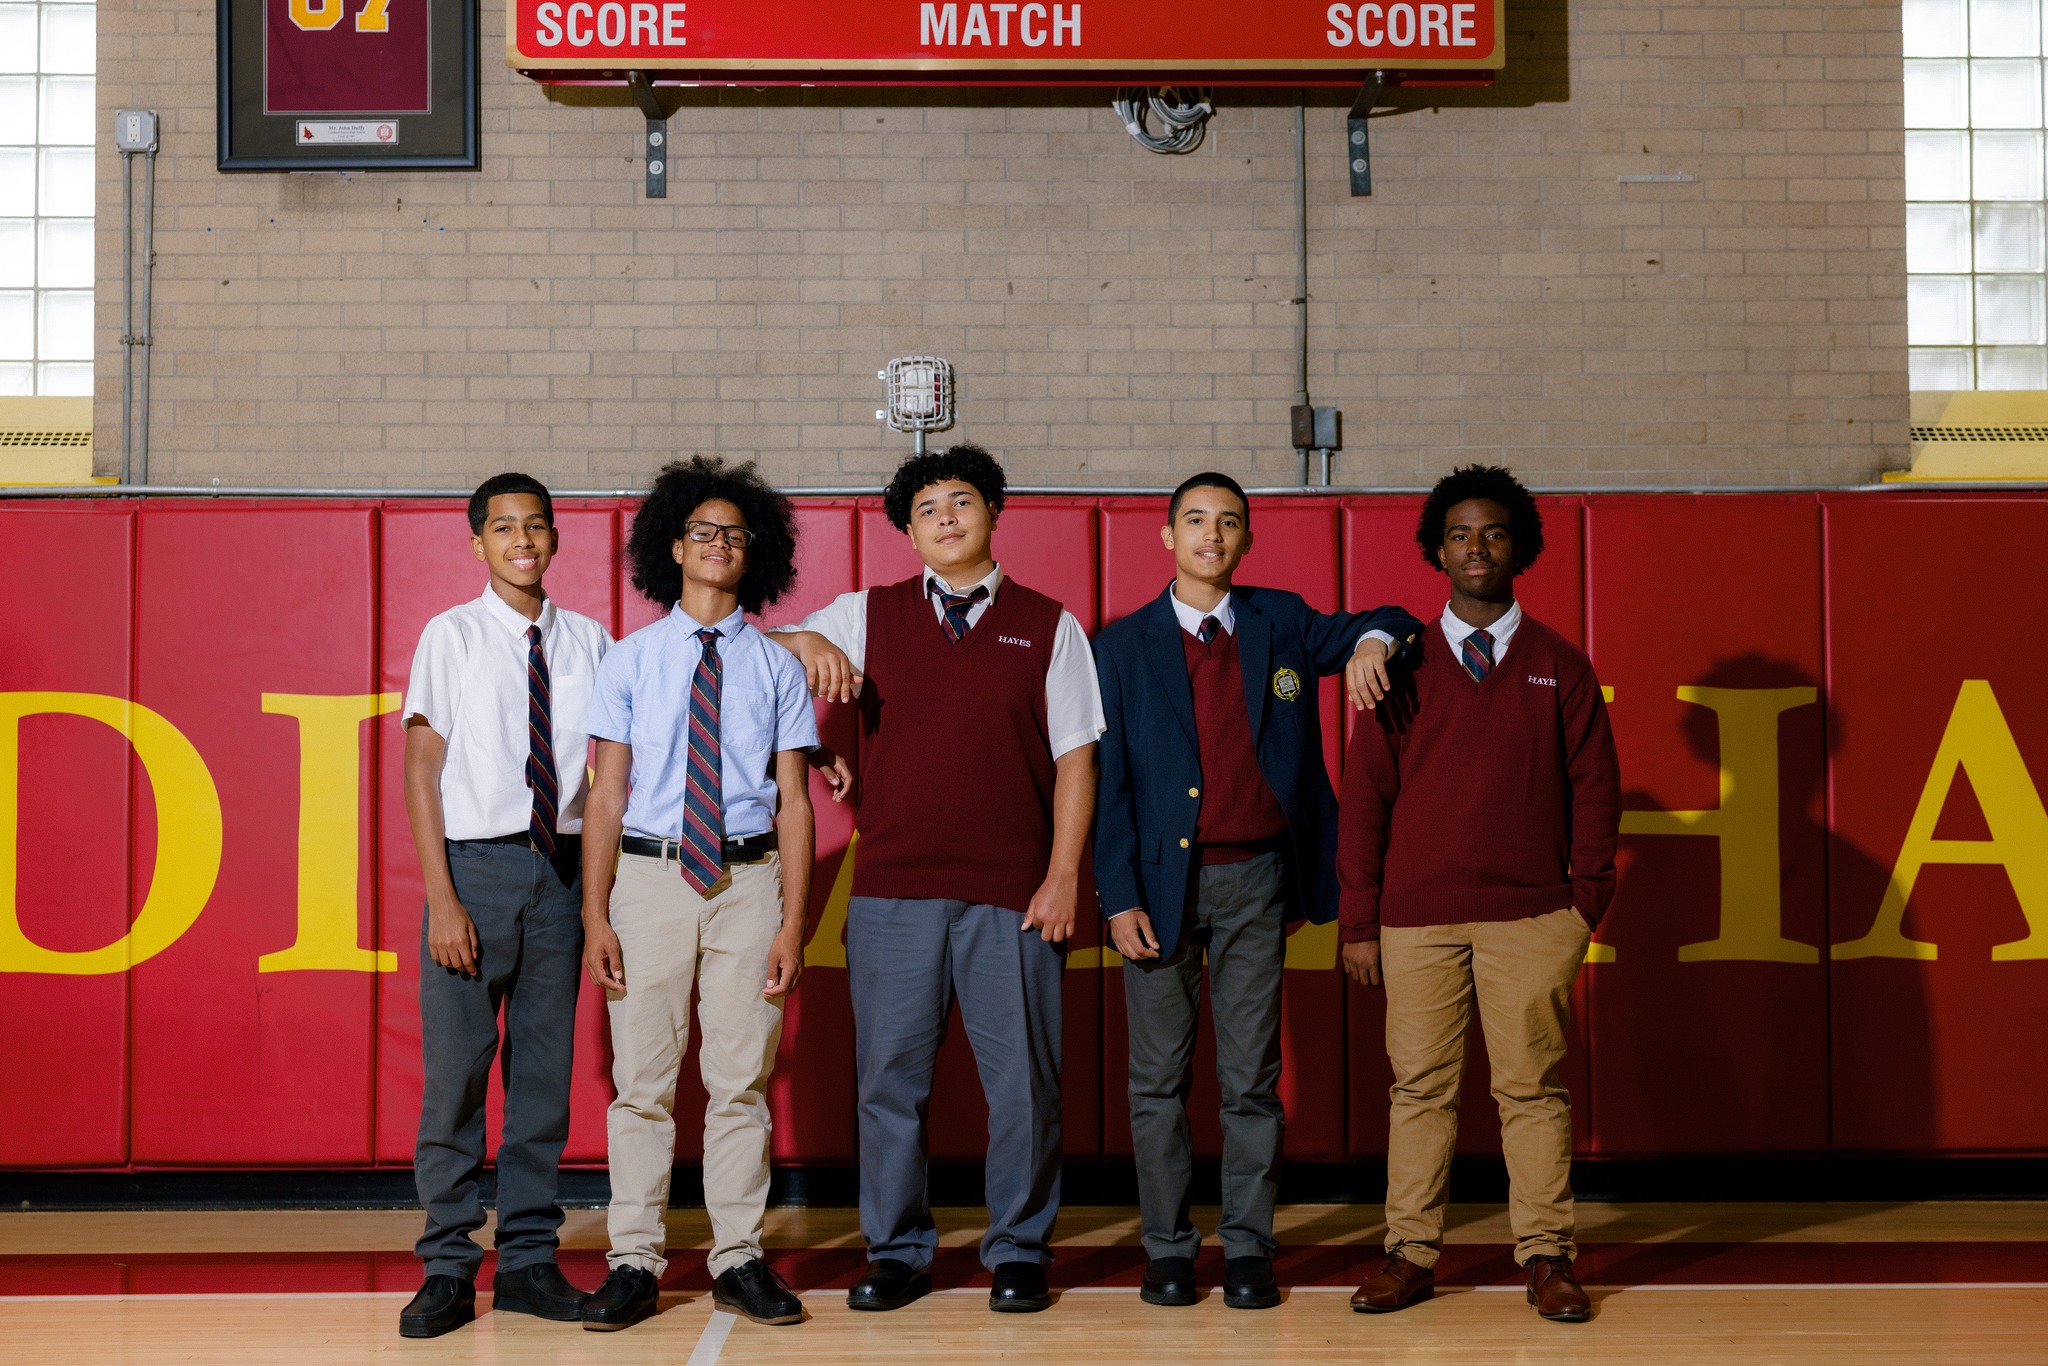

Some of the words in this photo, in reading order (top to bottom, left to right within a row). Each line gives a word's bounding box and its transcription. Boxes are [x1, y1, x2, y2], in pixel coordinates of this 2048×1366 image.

[536, 2, 686, 47] SCORE
[920, 2, 1081, 47] MATCH
[1326, 3, 1476, 47] SCORE
[998, 635, 1032, 648] HAYES
